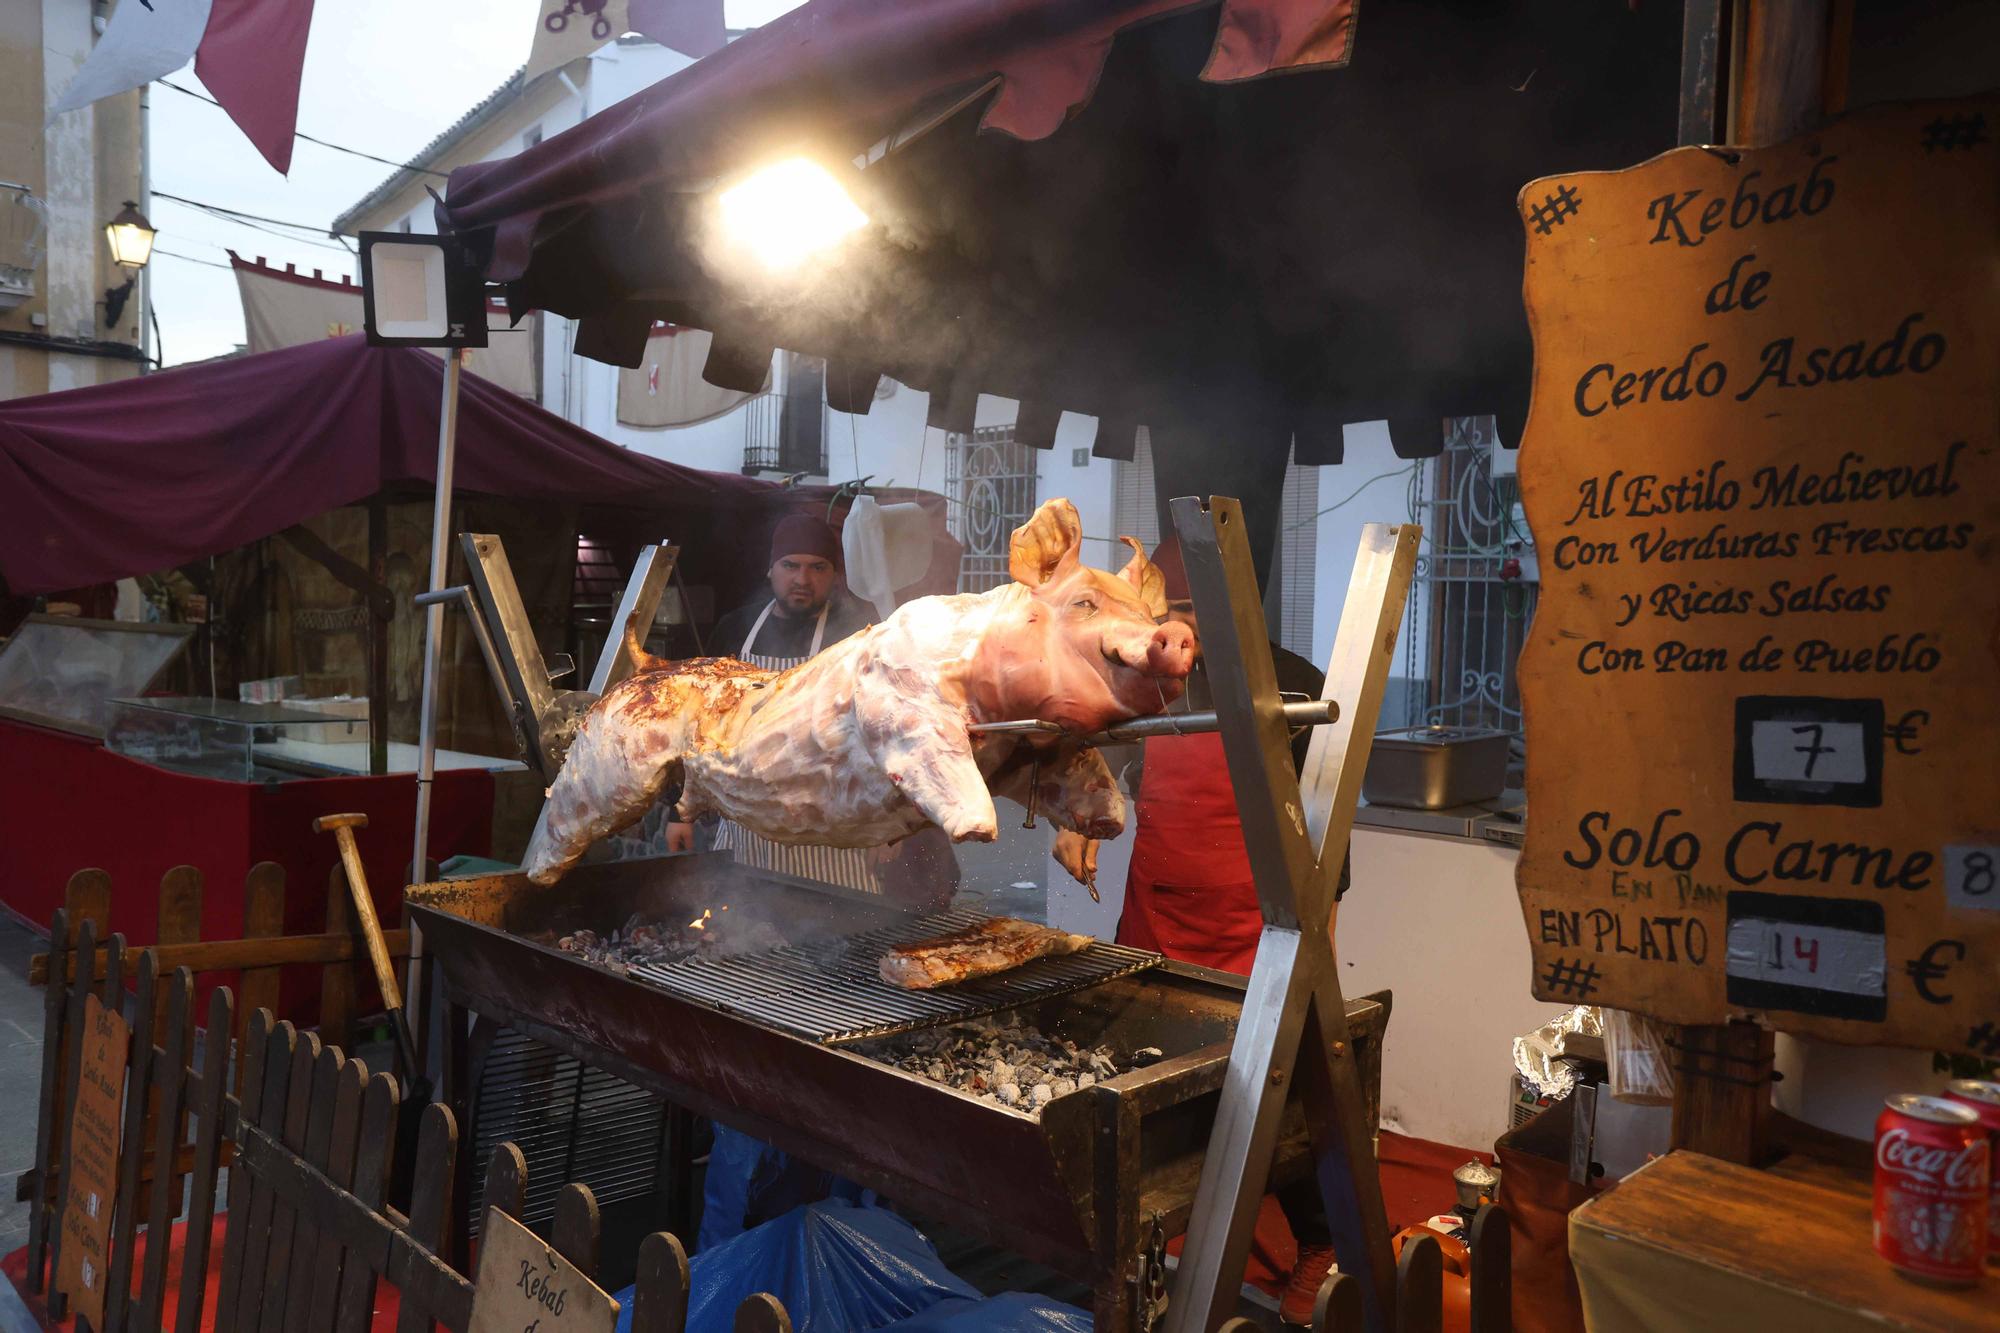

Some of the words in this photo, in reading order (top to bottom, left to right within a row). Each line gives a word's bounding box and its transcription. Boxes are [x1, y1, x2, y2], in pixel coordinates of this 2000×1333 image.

[1647, 155, 1838, 247] Kebab
[1704, 255, 1772, 315] de
[1574, 343, 1727, 418] Cerdo
[1735, 313, 1946, 401] Asado
[1565, 470, 1623, 526] Al
[1624, 460, 1740, 517] Estilo
[1750, 442, 1967, 511] Medieval
[1553, 535, 1619, 571] Con
[1630, 524, 1799, 564] Verduras
[1812, 521, 1975, 556] Frescas
[1615, 592, 1641, 627] y
[1649, 582, 1750, 618] Ricas
[1760, 574, 1891, 618] Salsas
[1577, 641, 1645, 676] Con
[1653, 641, 1727, 673] Pan
[1738, 636, 1783, 671] de
[1794, 633, 1942, 673] Pueblo
[1791, 724, 1836, 779] 7
[1885, 710, 1930, 755] €
[1563, 808, 1700, 872] Solo
[1724, 821, 1935, 891] Carne
[1962, 851, 1996, 896] 8
[1540, 908, 1581, 947] EN
[1585, 908, 1708, 966] PLATO
[1766, 932, 1818, 974] 14
[1906, 939, 1965, 1005] €
[516, 1260, 567, 1316] Kebab
